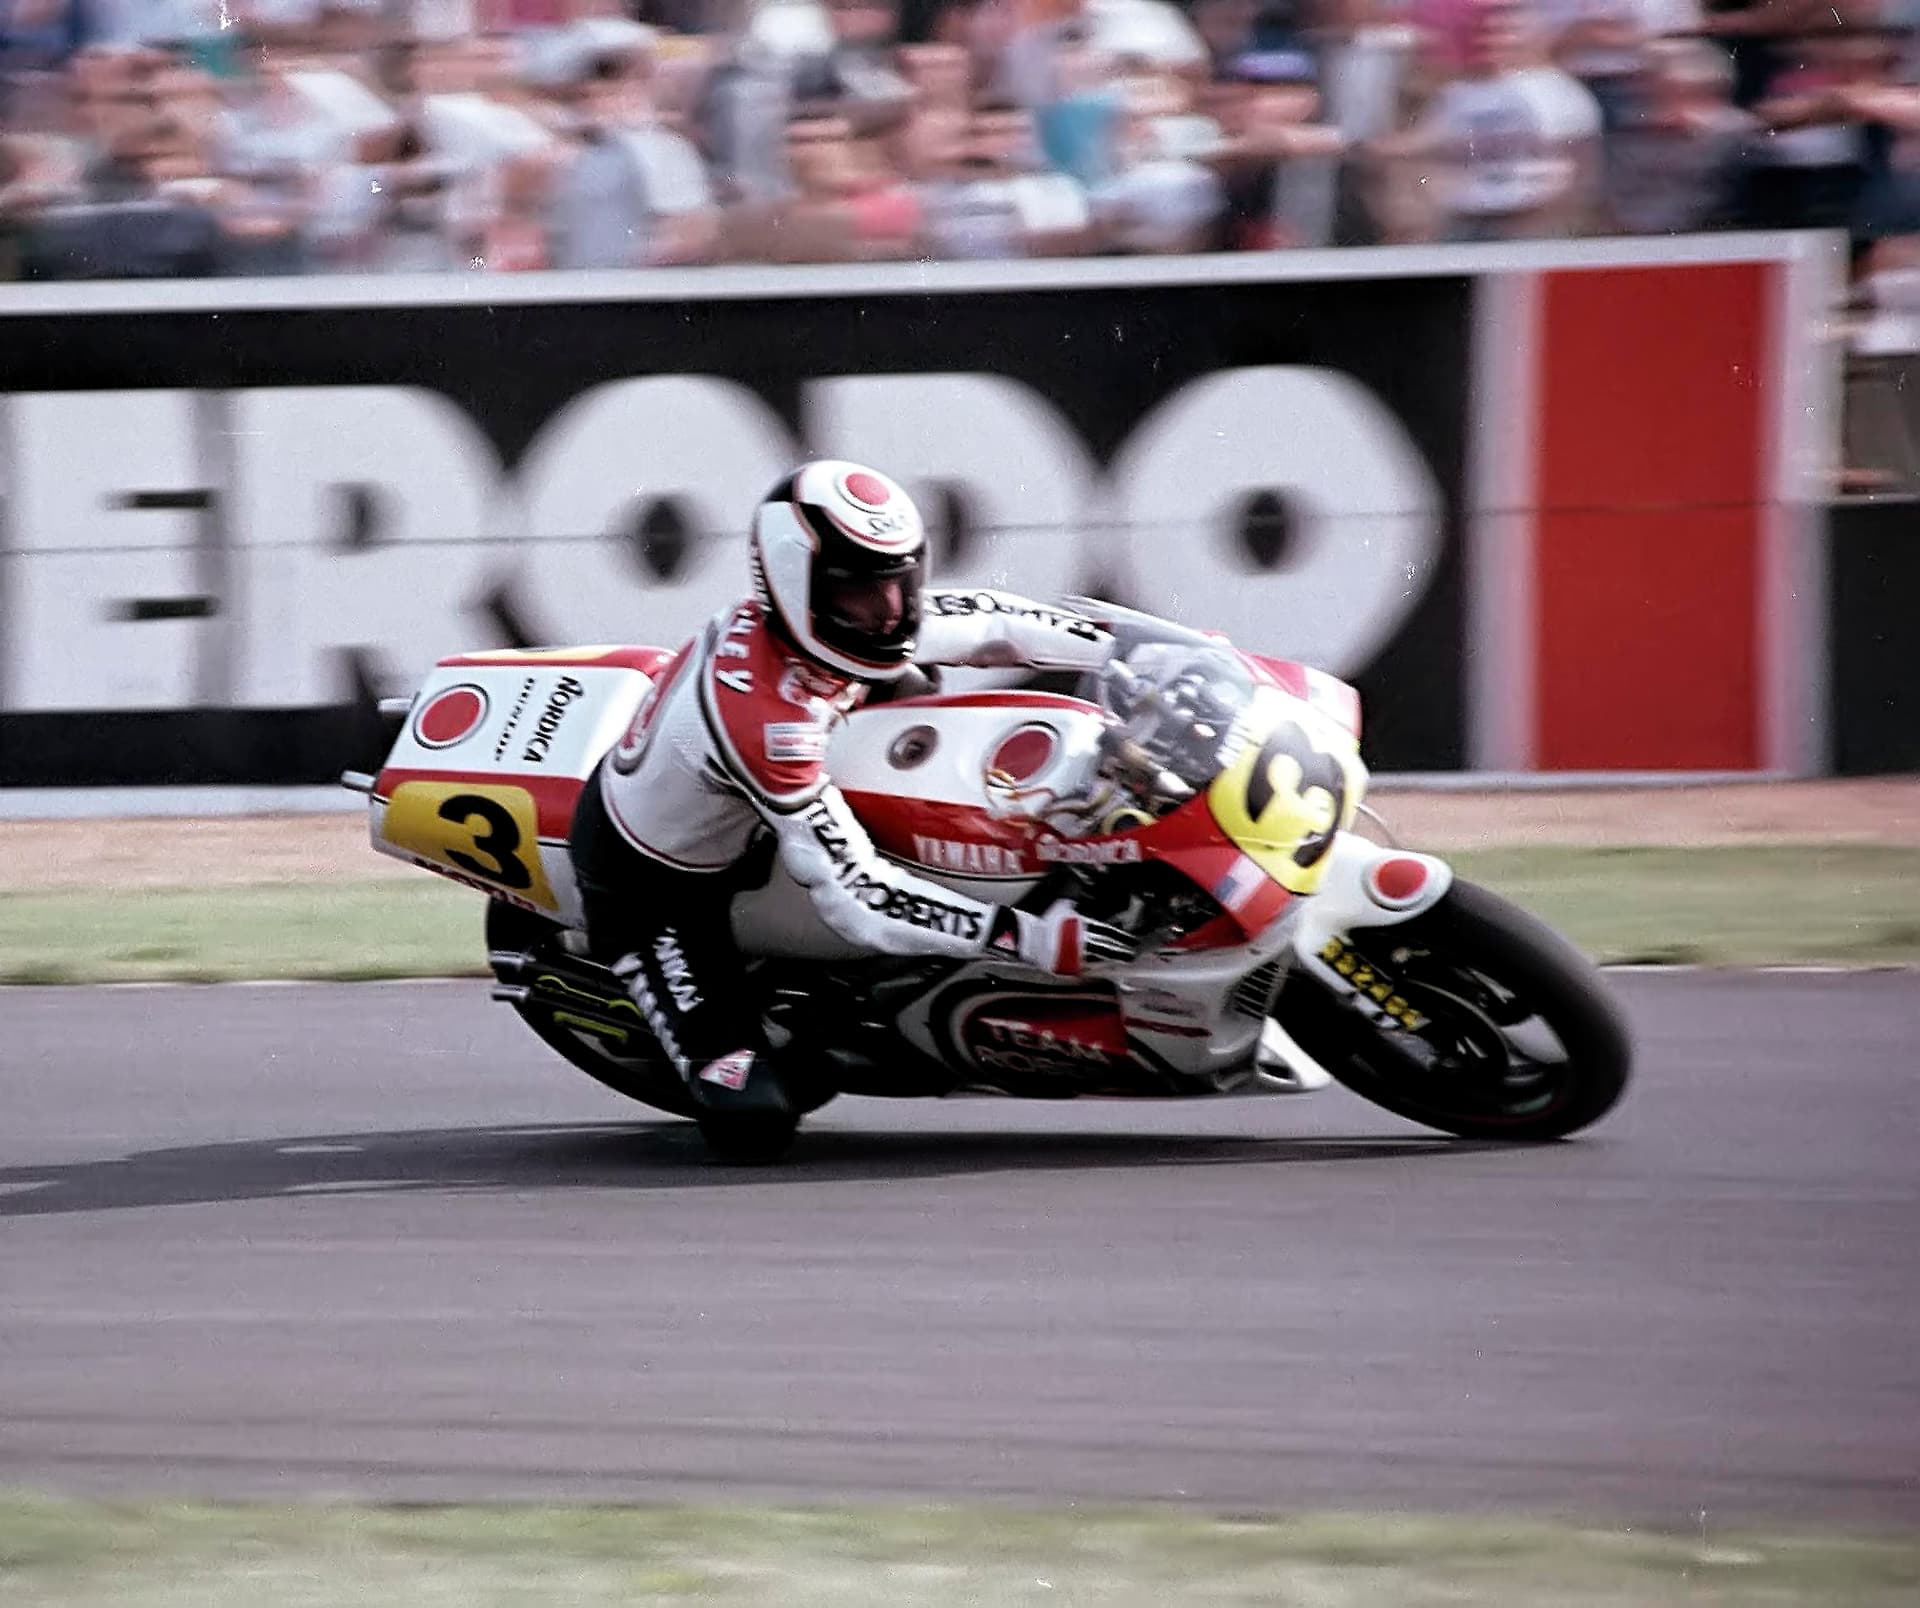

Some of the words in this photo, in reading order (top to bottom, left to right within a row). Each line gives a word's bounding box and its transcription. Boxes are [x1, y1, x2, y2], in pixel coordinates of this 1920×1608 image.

[522, 675, 585, 764] NORDICA
[1245, 719, 1347, 869] 3
[437, 793, 532, 890] 3
[844, 871, 984, 940] ROBERTS
